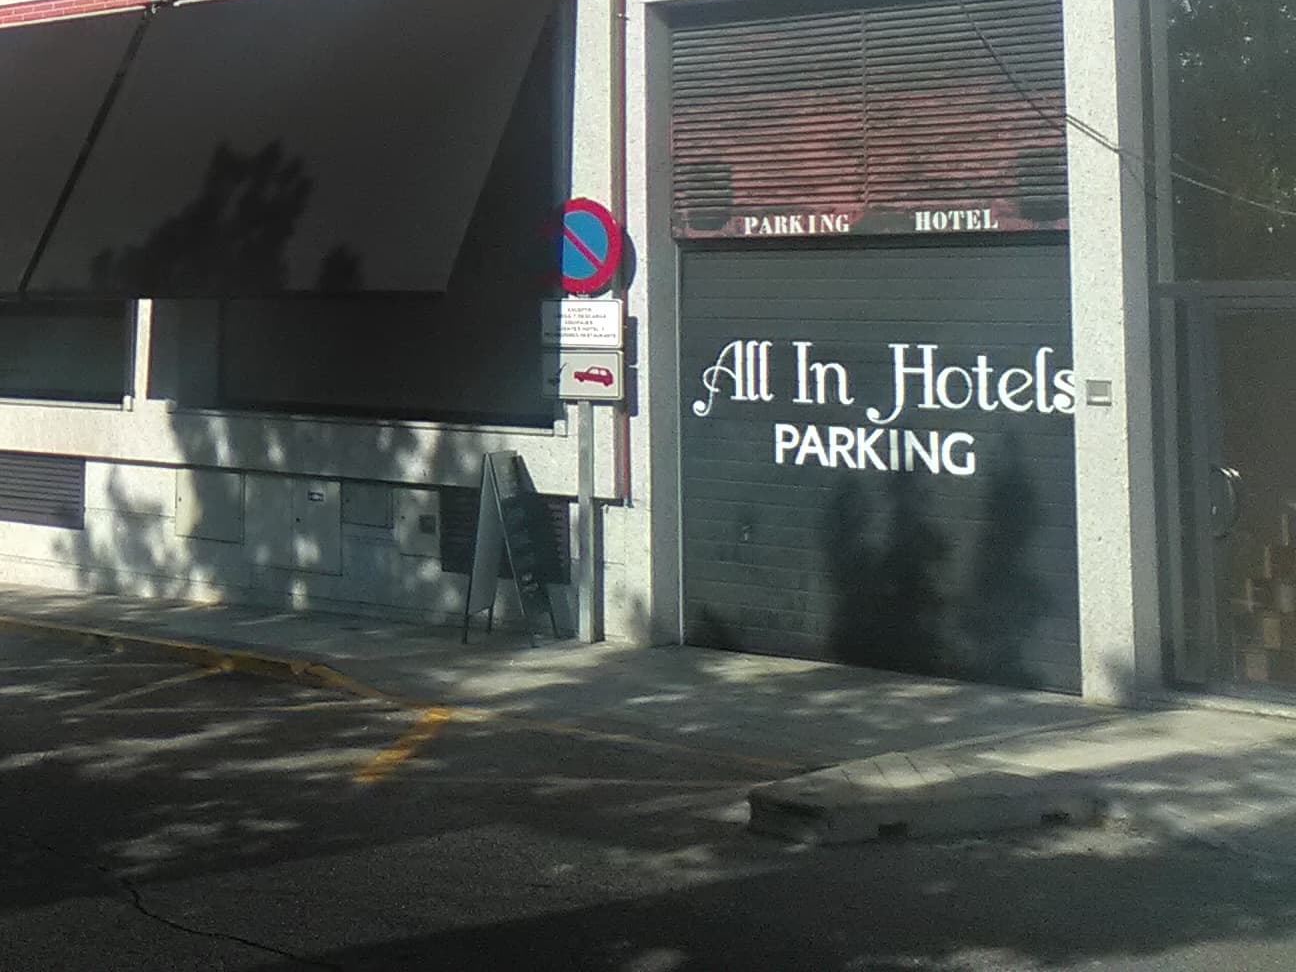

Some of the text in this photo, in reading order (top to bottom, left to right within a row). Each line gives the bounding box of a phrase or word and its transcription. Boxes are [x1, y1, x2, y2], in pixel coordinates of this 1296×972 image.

[744, 209, 999, 236] PARKING HOTEL
[692, 340, 1076, 425] All In Hotels
[775, 423, 976, 476] PARKING
